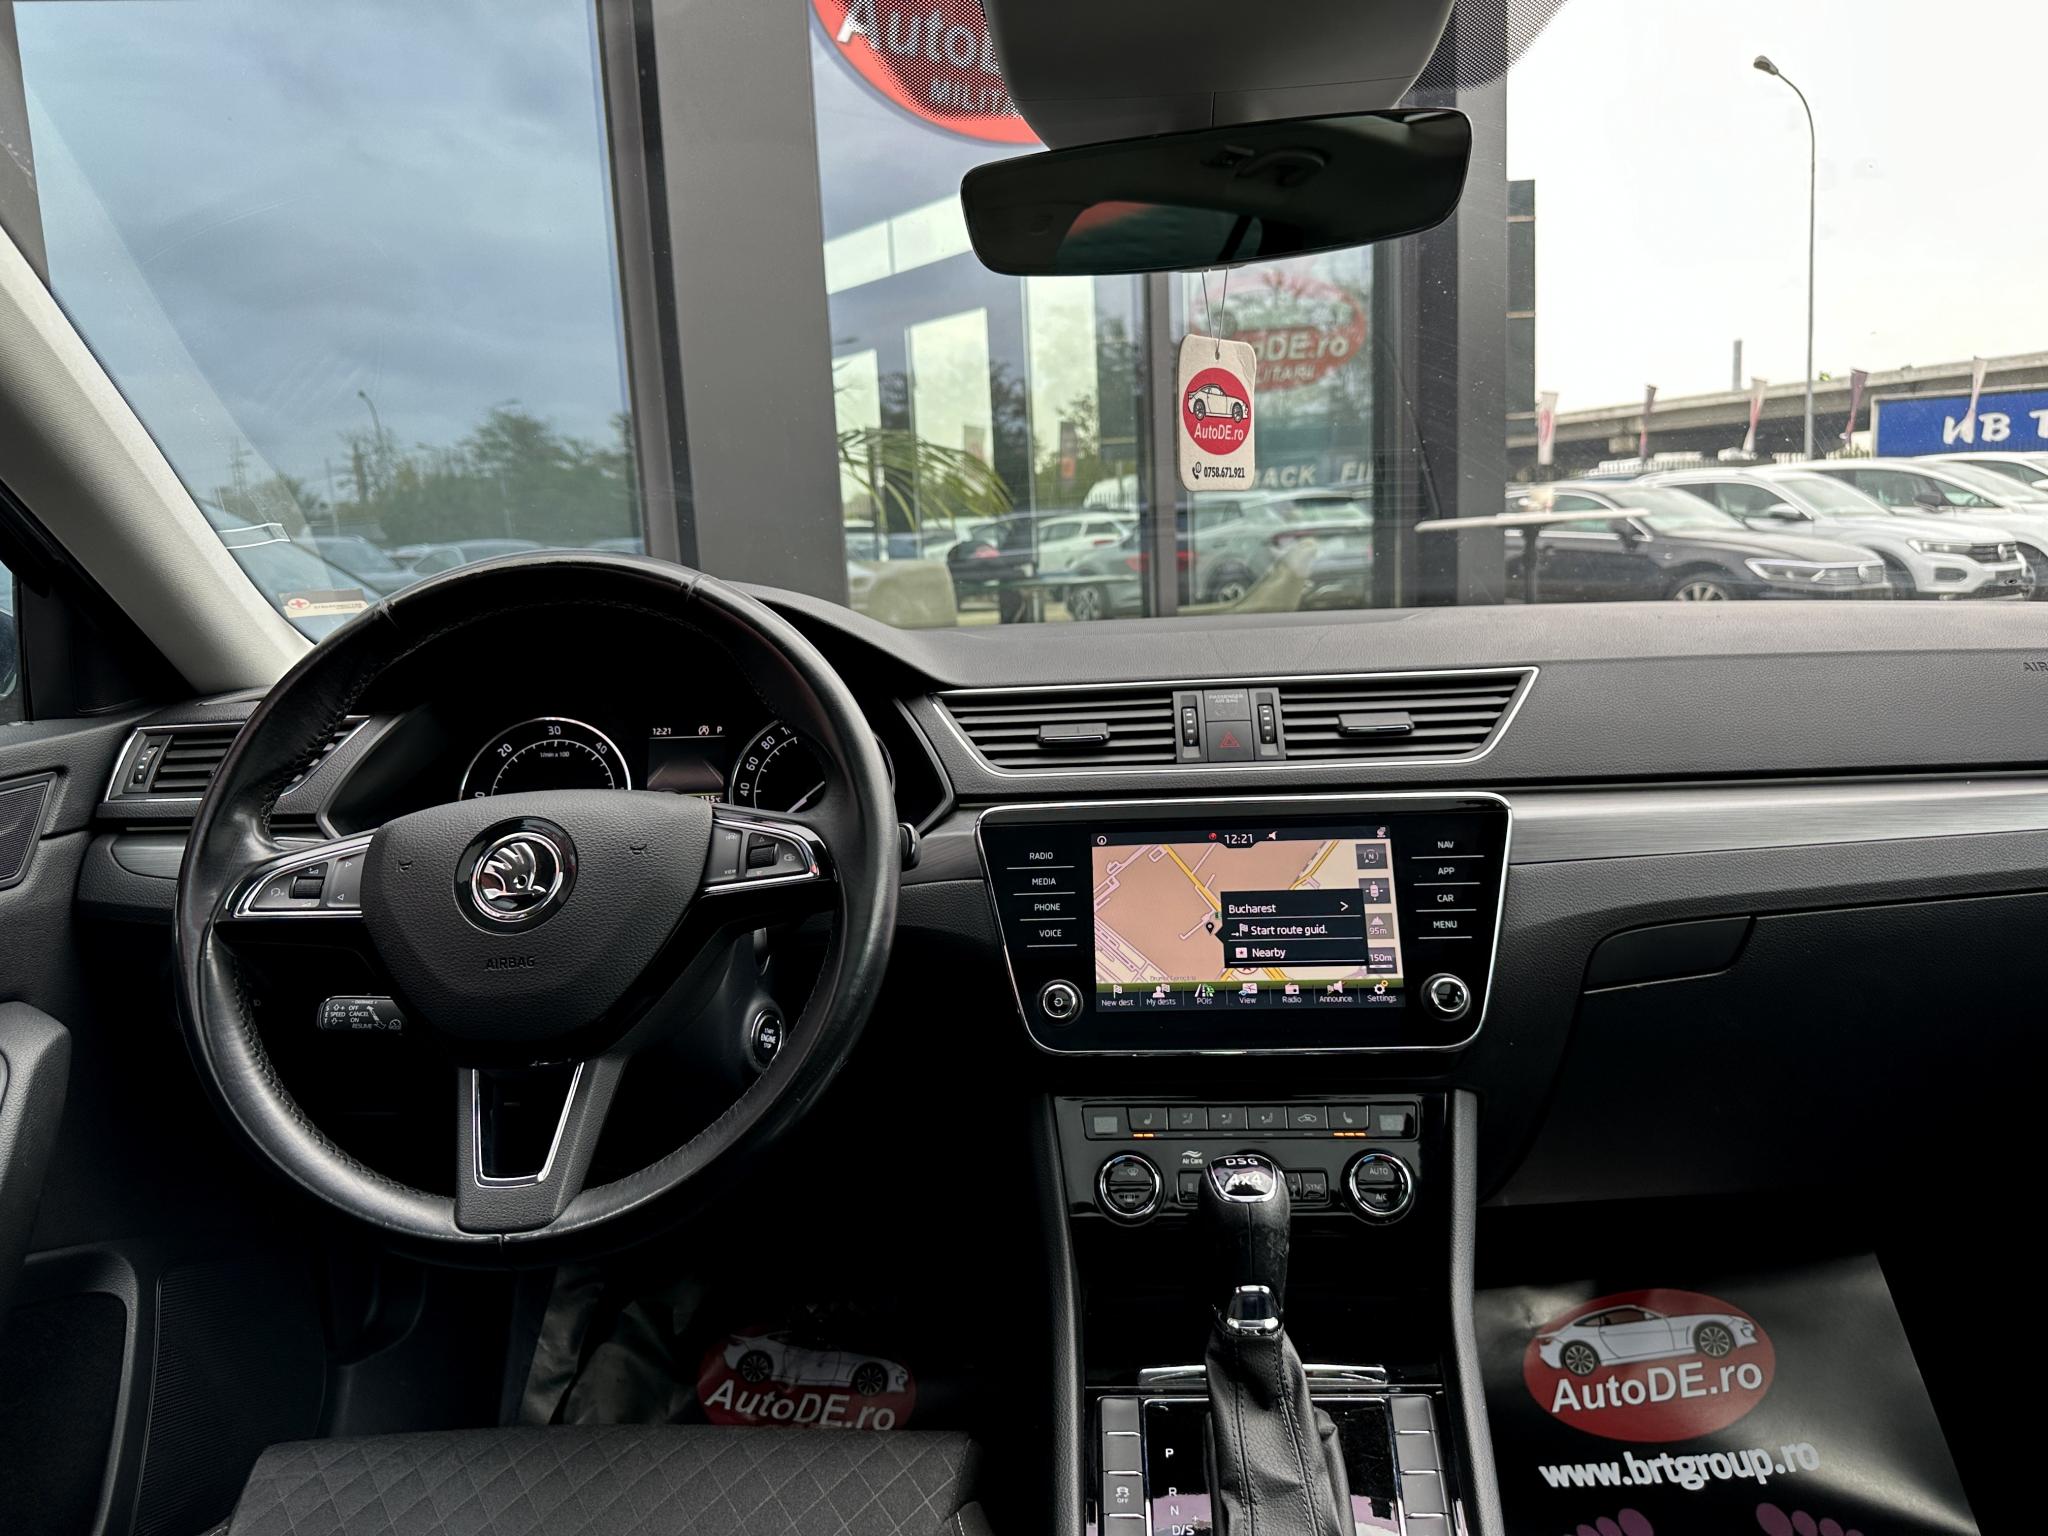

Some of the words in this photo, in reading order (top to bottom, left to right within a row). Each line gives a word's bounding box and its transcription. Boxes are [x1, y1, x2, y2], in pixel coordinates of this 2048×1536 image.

[1194, 424, 1244, 441] AutoDE.ro
[1204, 466, 1246, 478] 0758.671.921
[548, 726, 562, 735] 30
[594, 742, 608, 754] 40
[760, 736, 776, 750] 80
[498, 743, 512, 758] 20
[746, 756, 759, 771] 60
[740, 782, 750, 797] 40
[1224, 834, 1253, 844] 12:21
[1437, 840, 1454, 848] NAV
[1029, 852, 1054, 860] RADIO
[1438, 867, 1455, 875] APP
[1032, 878, 1056, 886] MEDIA
[1436, 894, 1454, 902] CAR
[1034, 902, 1061, 911] PHONE
[1228, 904, 1276, 914] Bucharest
[1432, 920, 1458, 928] MENU
[1039, 929, 1062, 937] VOICE
[1251, 926, 1274, 935] Start
[1277, 926, 1303, 935] route
[1304, 924, 1328, 936] guid.
[1252, 948, 1286, 959] Nearby
[1370, 954, 1392, 962] 150m
[486, 956, 536, 970] AIRBAG
[1367, 994, 1397, 1003] Settings
[1229, 1172, 1263, 1185] 4x4
[1551, 1361, 1763, 1413] AutoDE.ro
[704, 1378, 896, 1432] AutoDE.ro
[1165, 1448, 1174, 1458] P
[1538, 1441, 1821, 1491] www.brtgroup.ro
[1168, 1487, 1178, 1496] R
[1170, 1505, 1179, 1516] N
[1172, 1524, 1195, 1536] D/S
